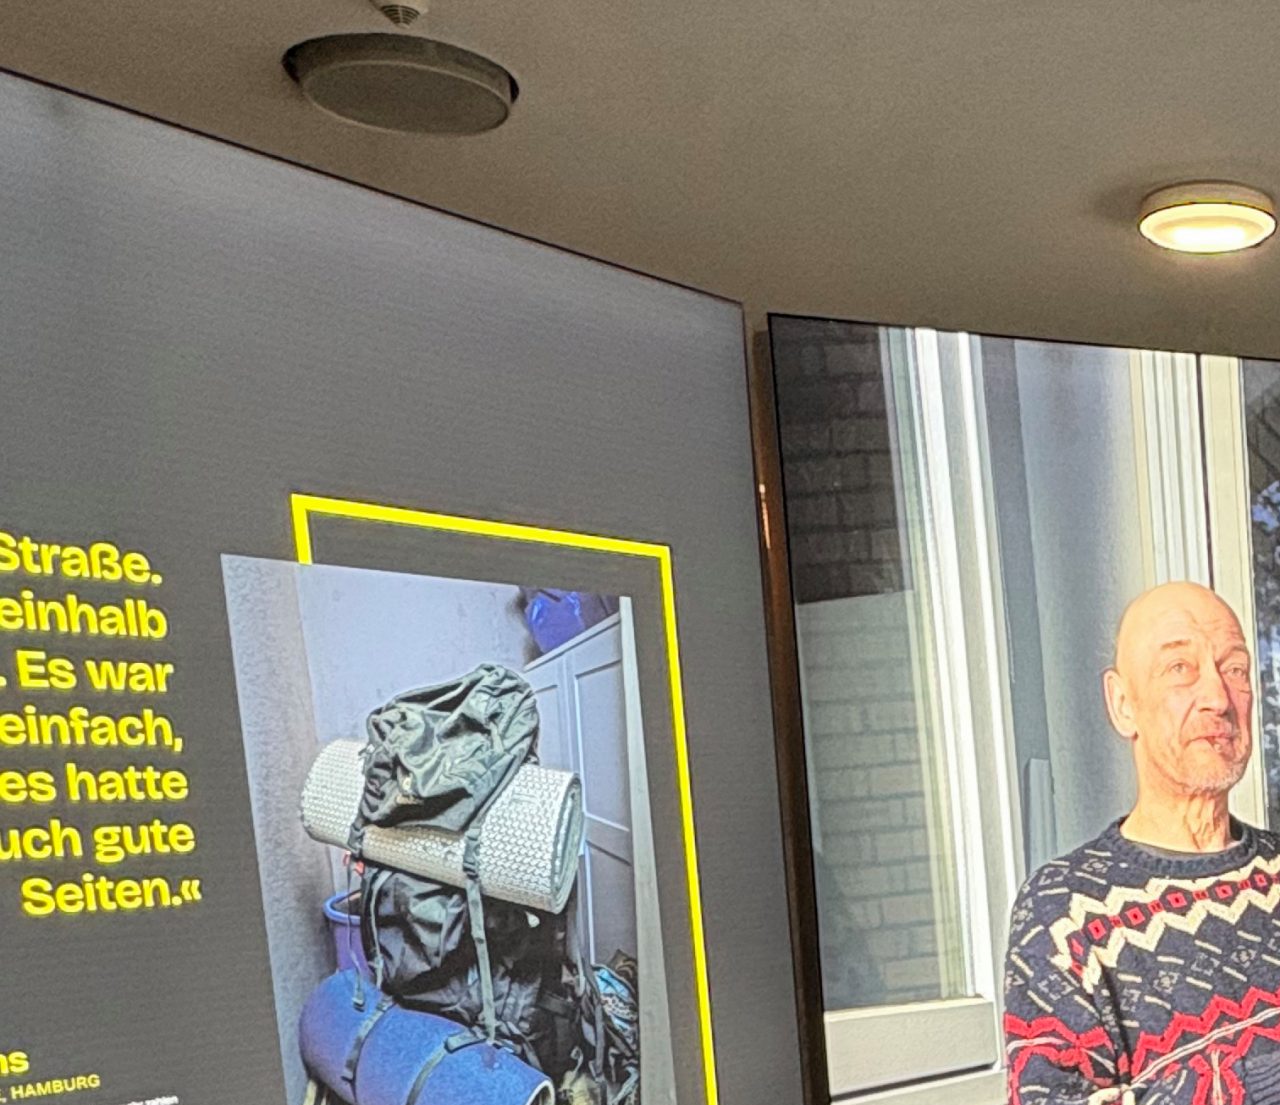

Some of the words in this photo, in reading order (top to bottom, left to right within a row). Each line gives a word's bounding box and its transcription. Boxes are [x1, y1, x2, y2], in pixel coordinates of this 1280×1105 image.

[0, 532, 162, 586] Straße.
[0, 590, 167, 640] einhalb
[16, 650, 77, 692] Es
[85, 660, 173, 693] war
[0, 705, 182, 753] einfach,
[0, 771, 57, 805] es
[66, 763, 188, 803] hatte
[0, 819, 83, 862] uch
[94, 820, 195, 865] gute
[21, 873, 201, 917] Seiten.«
[11, 1074, 100, 1099] HAMBURG
